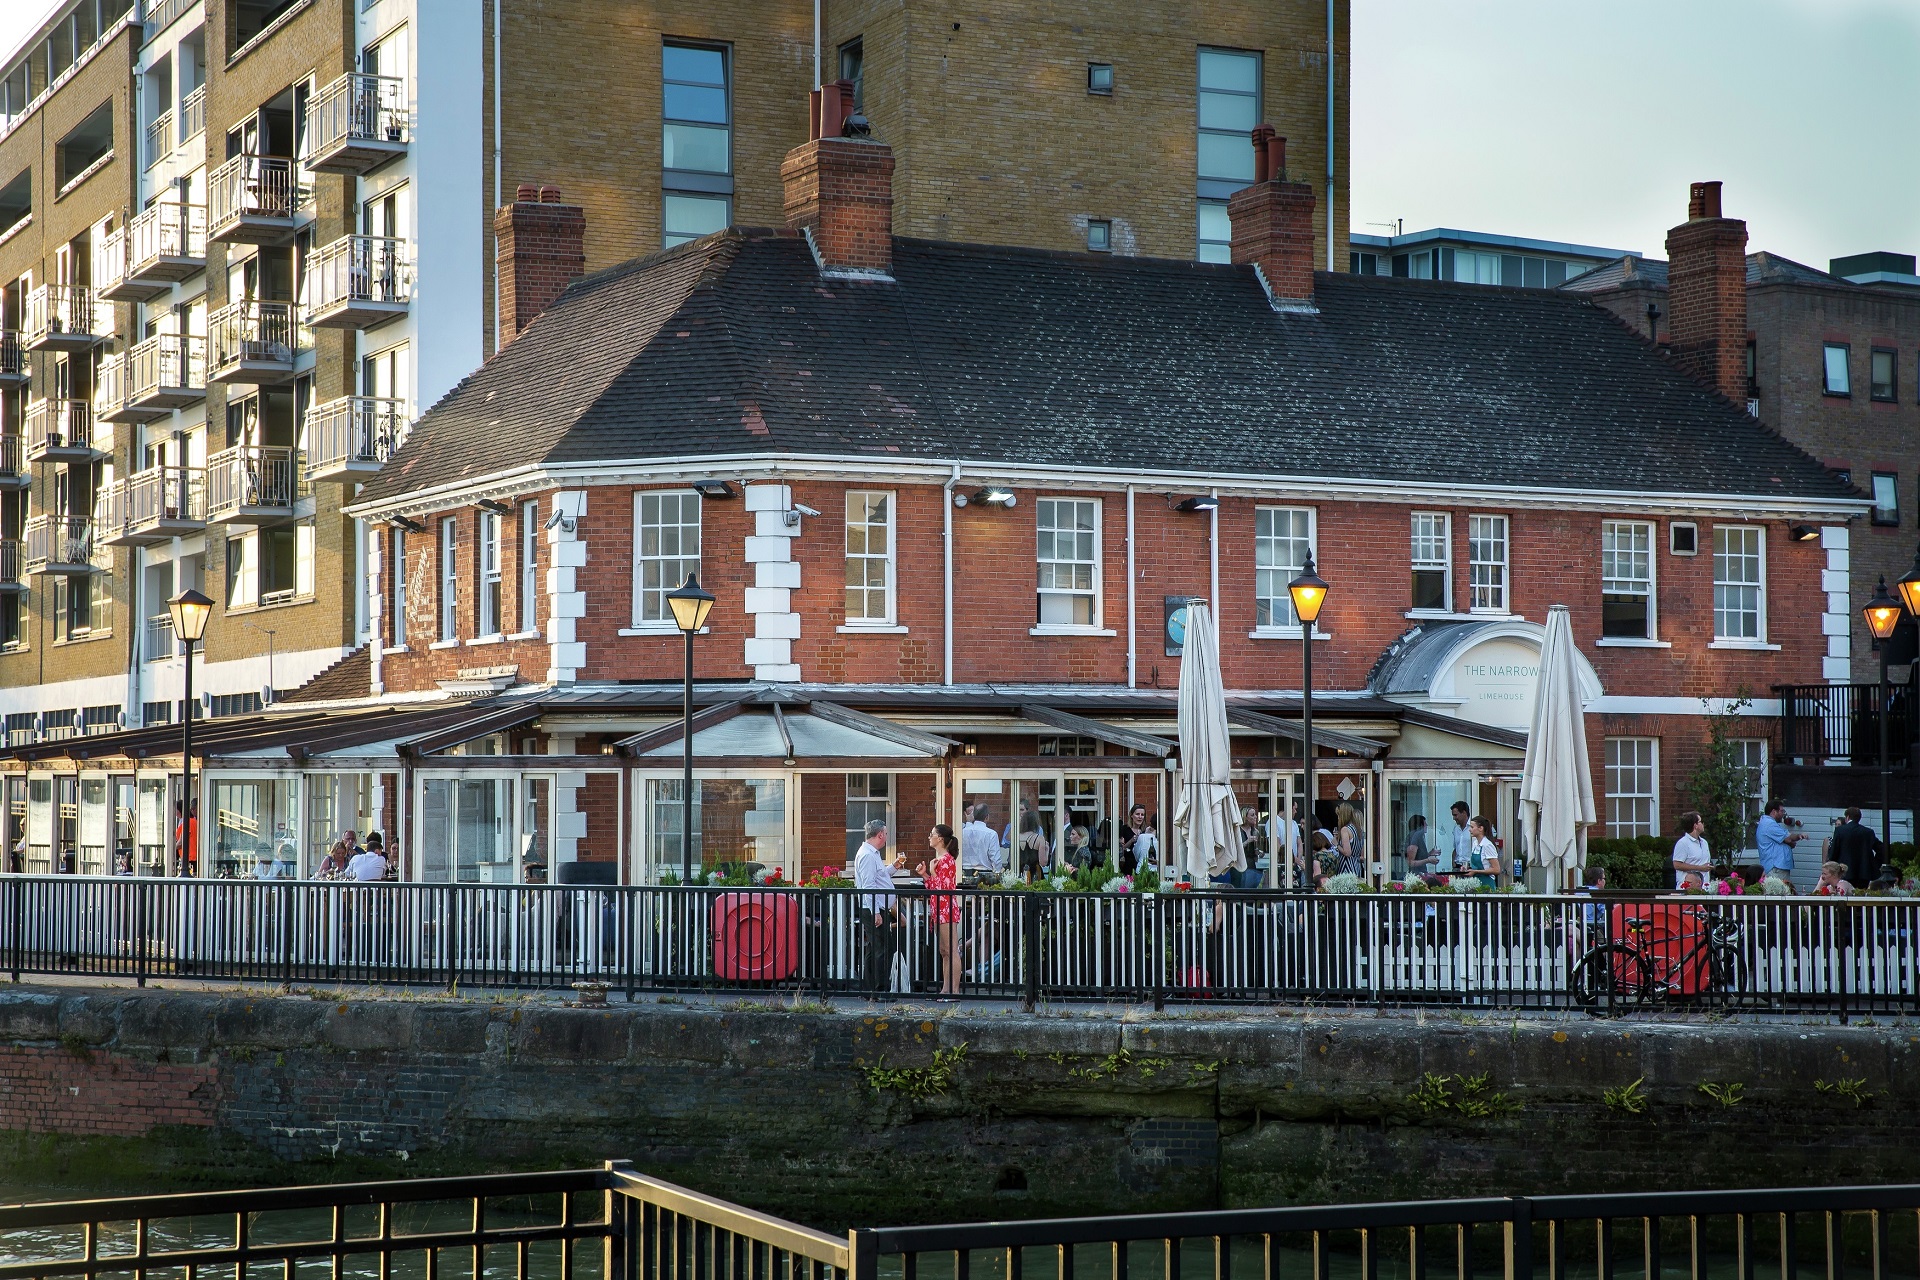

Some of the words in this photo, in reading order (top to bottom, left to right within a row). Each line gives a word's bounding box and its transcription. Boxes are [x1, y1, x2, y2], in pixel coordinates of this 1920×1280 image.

[1464, 665, 1486, 677] THE
[1489, 665, 1539, 677] NARROW
[1479, 692, 1525, 701] LIMEHOUSE
